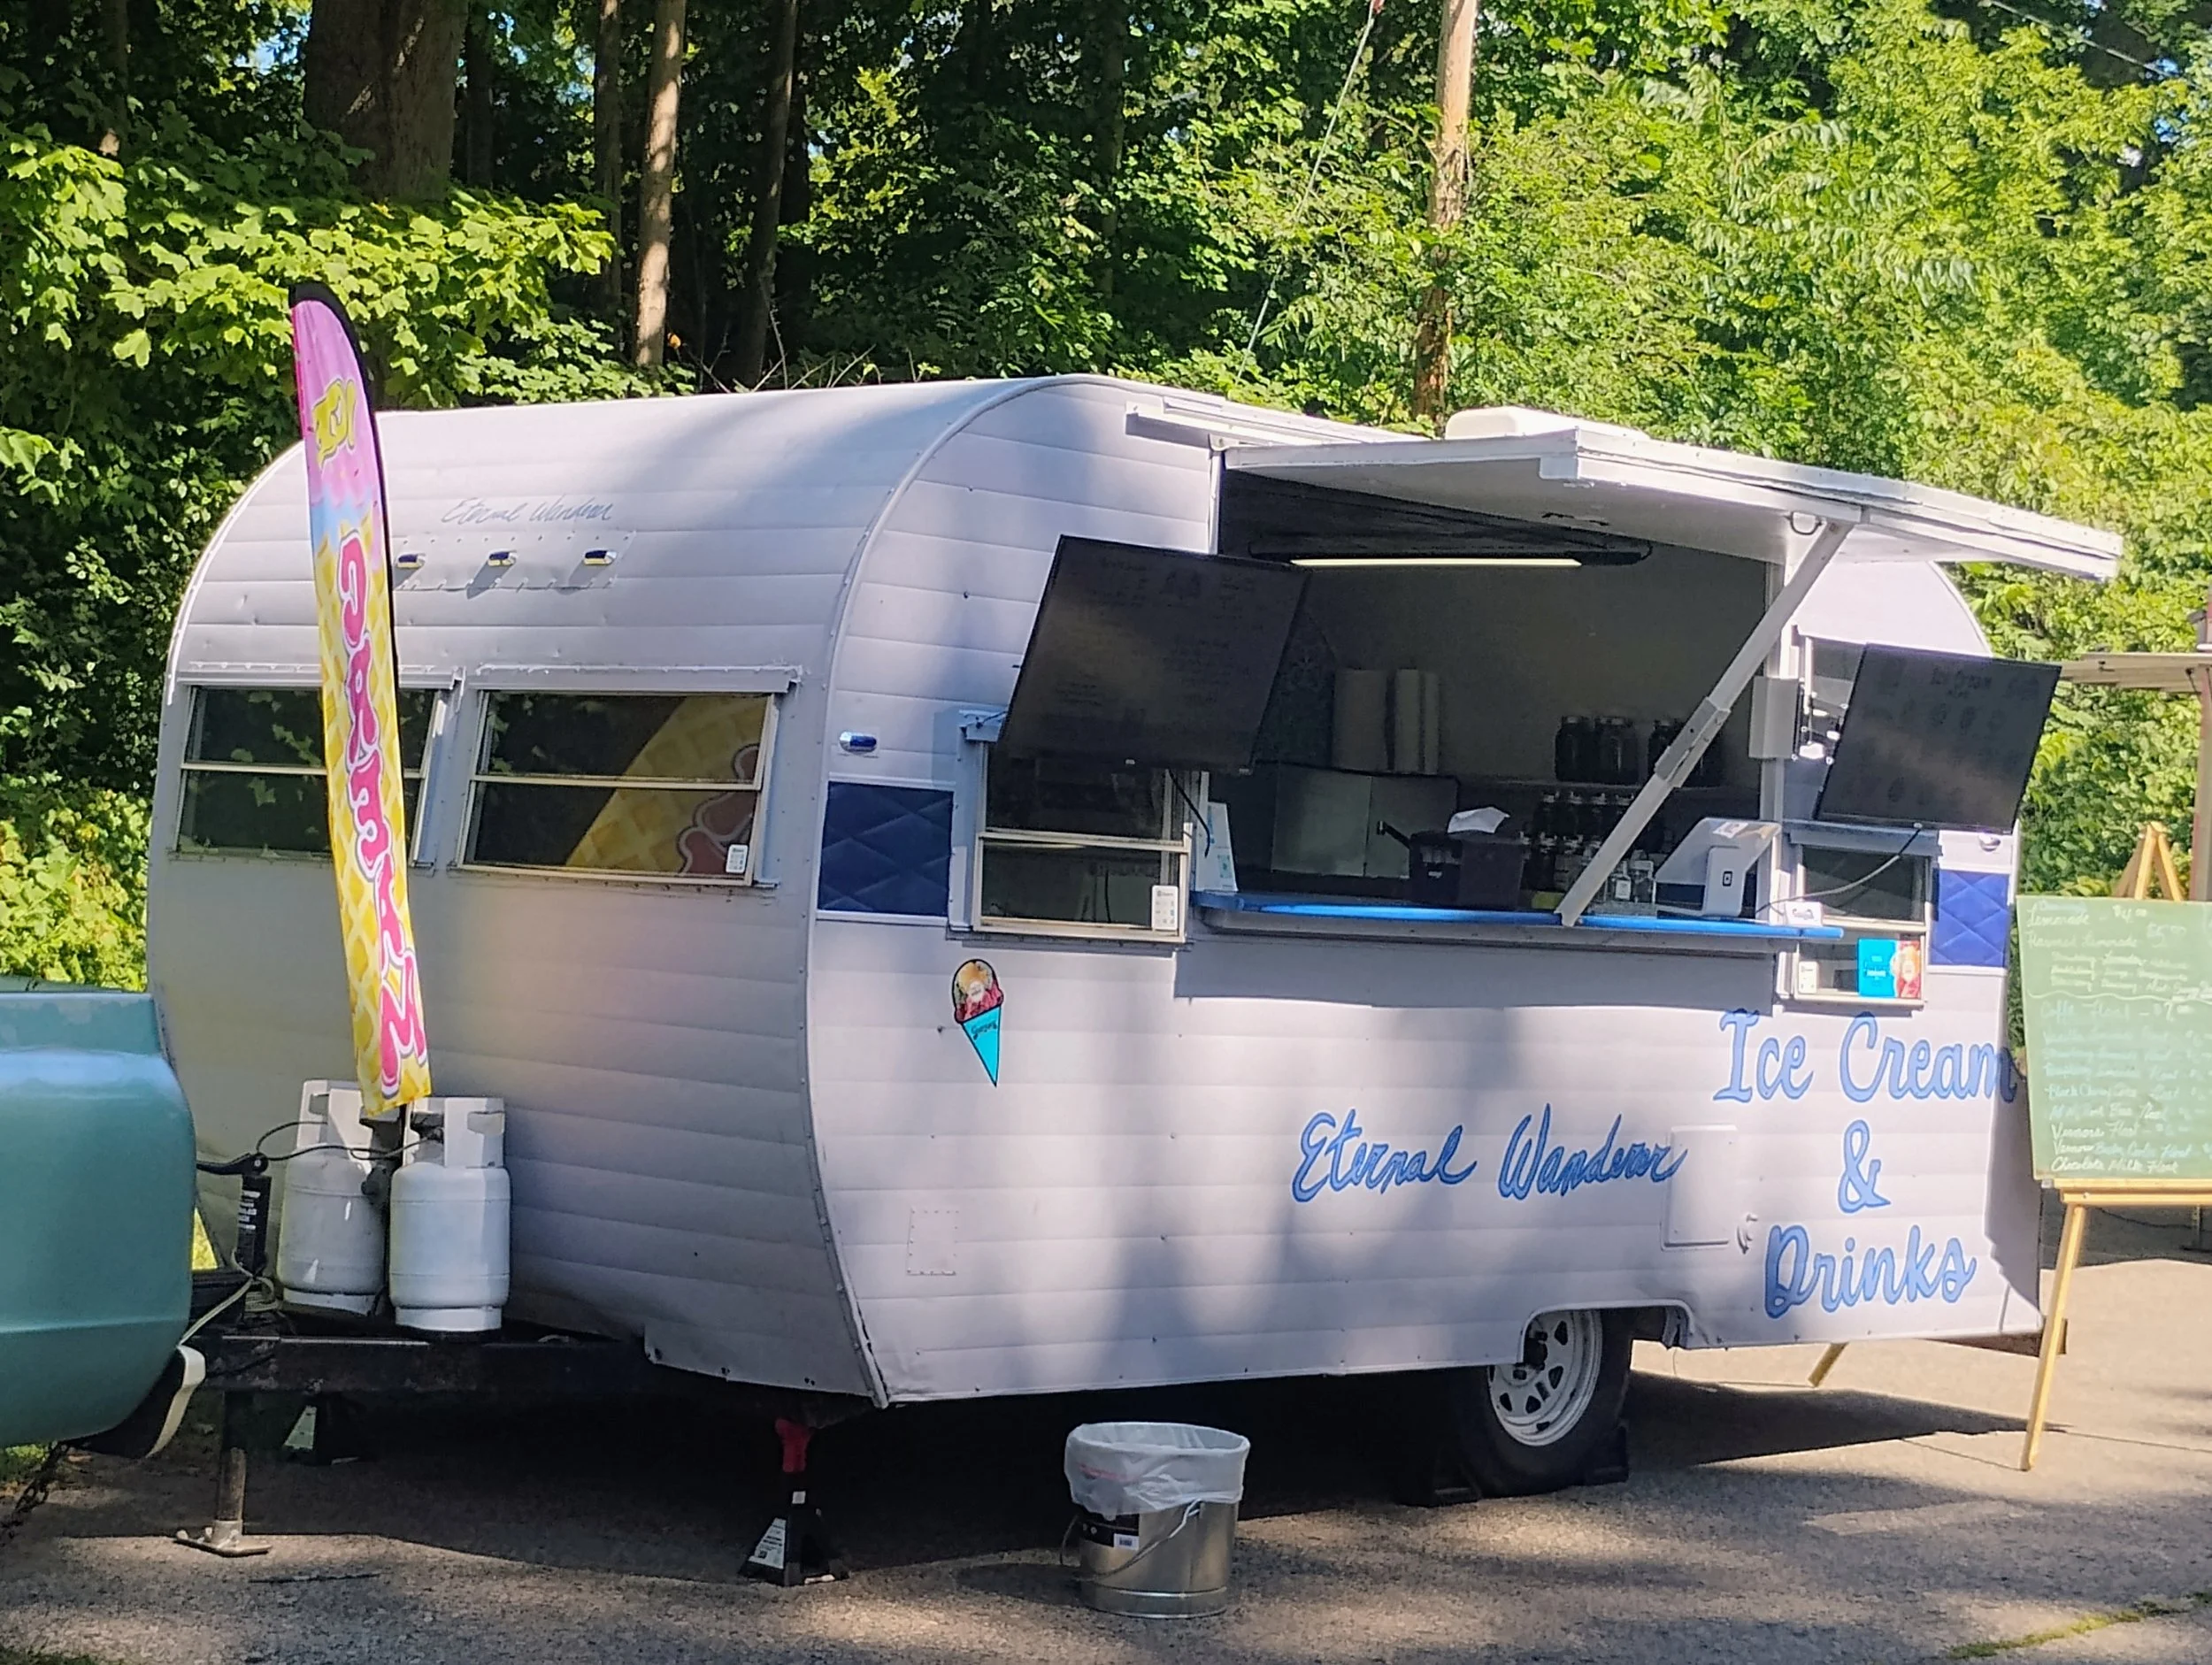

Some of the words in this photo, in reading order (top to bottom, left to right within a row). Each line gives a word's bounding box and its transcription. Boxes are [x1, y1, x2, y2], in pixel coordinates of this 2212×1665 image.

[1712, 1008, 1814, 1103] Ice
[1839, 1010, 2018, 1104] Cream
[1292, 1109, 1478, 1202] Eternal
[1498, 1102, 1688, 1200] Wanderer
[1837, 1118, 1892, 1214] &
[1763, 1224, 1978, 1320] Drinks
